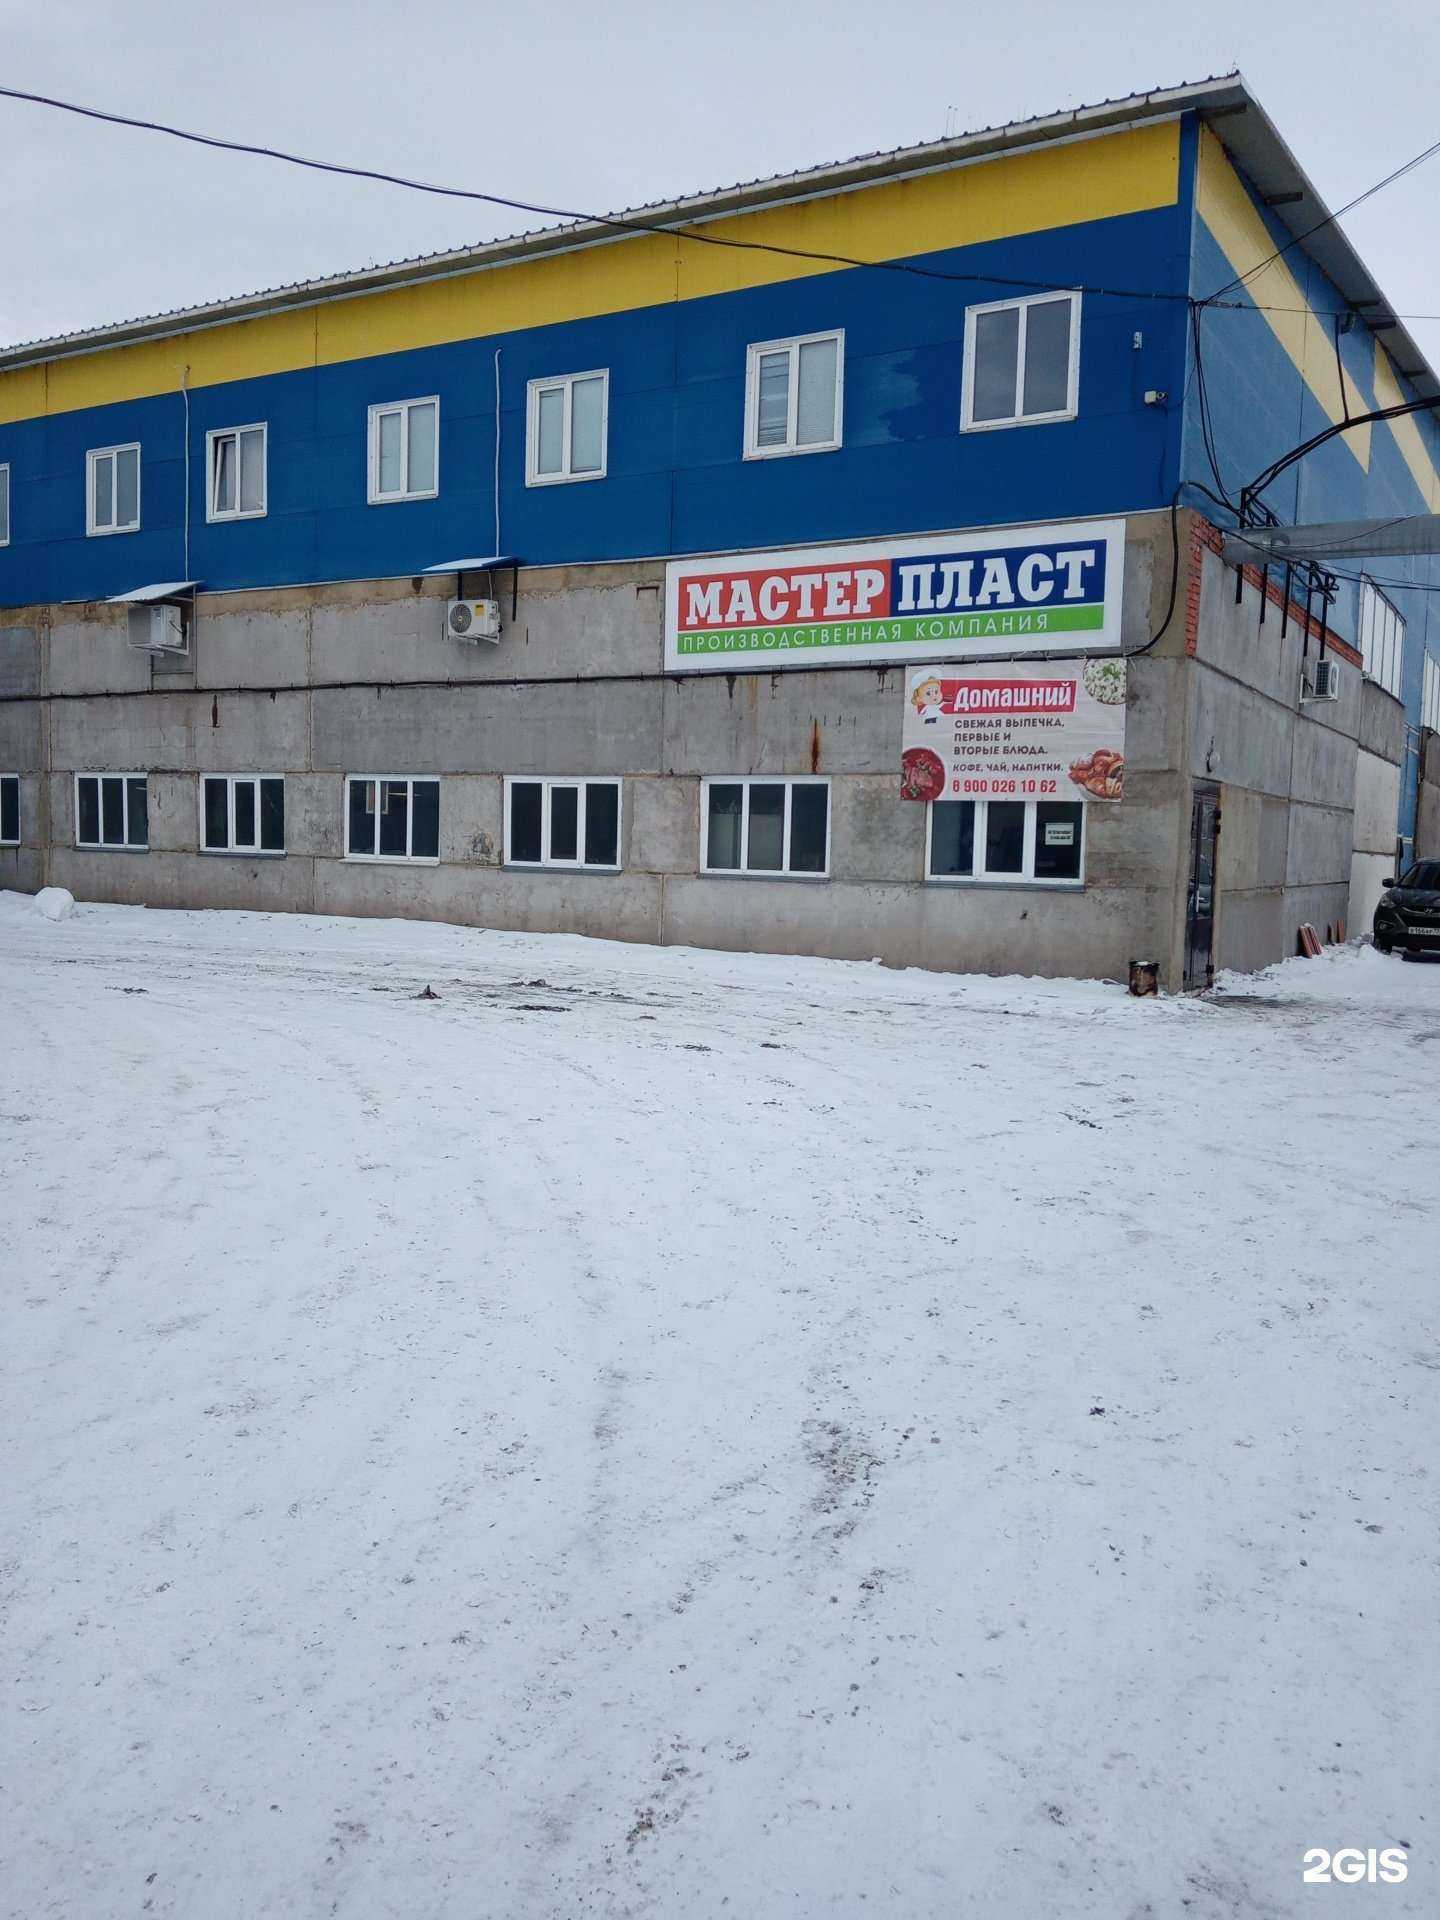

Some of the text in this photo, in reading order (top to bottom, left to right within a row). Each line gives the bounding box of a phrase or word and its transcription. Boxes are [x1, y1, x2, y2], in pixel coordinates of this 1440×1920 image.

[686, 549, 1096, 626] МАСТЕР ПЛАСТ
[683, 613, 1048, 652] ПРОИЗВОДСТВЕННАЯ КОМПАНИЯ
[953, 682, 1072, 712] Домашний
[954, 718, 1065, 729] СВЕЖАЯ ВЫПЕЧКА,
[954, 732, 1012, 742] ПЕРВЫЕ И
[953, 745, 1048, 755] ВТОРЫЕ БЛЮДА.
[953, 761, 1064, 773] КОФЕ, ЧАЙ, НАПИТКИ.
[952, 780, 1057, 793] 8 900 026 10 62
